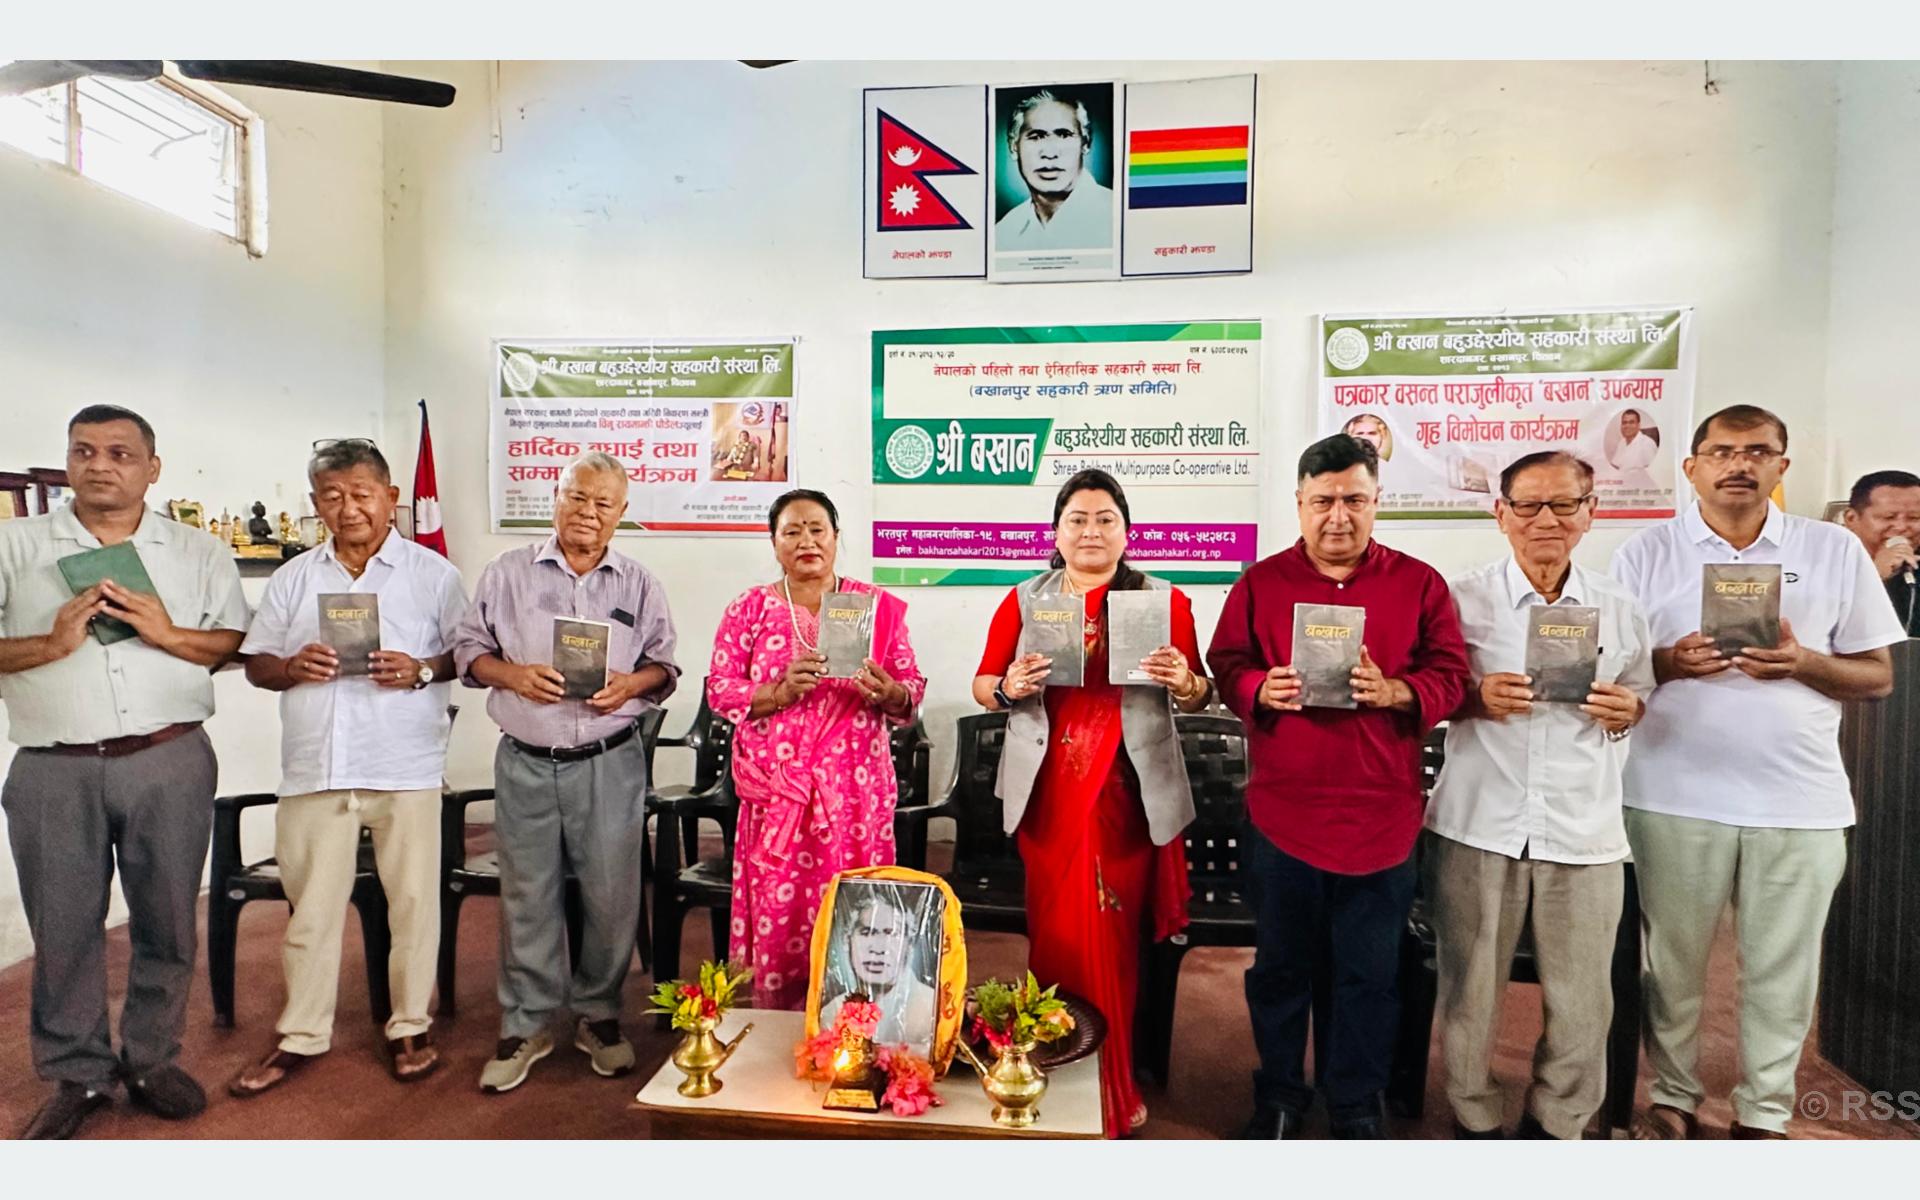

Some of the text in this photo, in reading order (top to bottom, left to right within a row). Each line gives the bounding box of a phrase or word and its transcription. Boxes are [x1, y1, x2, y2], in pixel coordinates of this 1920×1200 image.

[1373, 330, 1393, 351] श्री
[1396, 333, 1440, 350] बखान
[1529, 325, 1591, 348] सहकारी
[1594, 324, 1638, 346] संस्था
[541, 357, 557, 374] श्री
[670, 356, 721, 374] सहकारी
[723, 357, 760, 374] संस्था
[933, 363, 976, 377] नेपालको
[982, 361, 1013, 377] पहिलो
[1019, 365, 1040, 376] तथा
[1045, 361, 1099, 378] ऐतिहासिक
[1104, 360, 1147, 378] सहकारी
[969, 380, 1177, 400] (बखानपुर सहकारी ऋण समिति)
[1334, 383, 1391, 407] पत्रकार
[1443, 376, 1533, 410] पराजुलीकृत
[1600, 378, 1664, 402] उपन्यास
[1416, 414, 1580, 449] गृह विमोचन कार्यक्रम
[508, 436, 581, 458] हार्दिक
[653, 441, 699, 458] तथा
[936, 420, 966, 476] श्री
[970, 433, 1038, 476] बखान
[1130, 422, 1184, 448] सहकारी
[1188, 424, 1225, 448] संस्था
[1053, 459, 1078, 475] Shree
[1115, 461, 1171, 479] Multipurpose
[1173, 459, 1232, 479] Co-operative
[1235, 460, 1251, 475] Ltd.
[877, 528, 909, 543] भरतपुर
